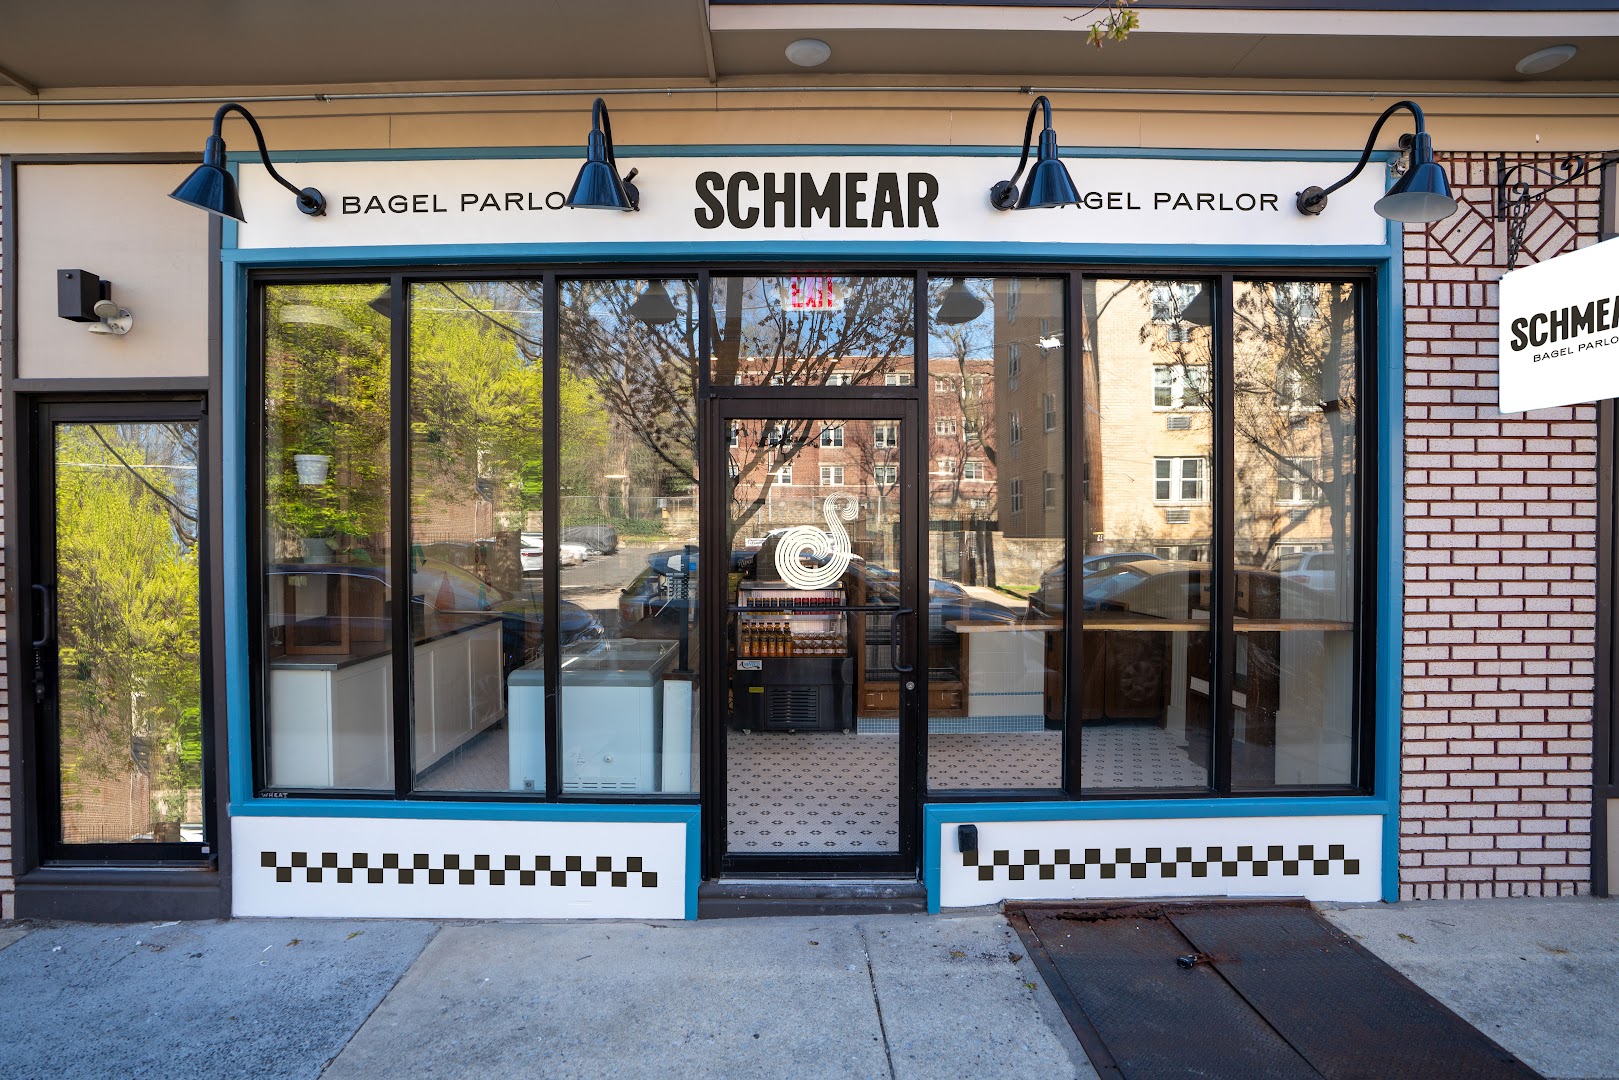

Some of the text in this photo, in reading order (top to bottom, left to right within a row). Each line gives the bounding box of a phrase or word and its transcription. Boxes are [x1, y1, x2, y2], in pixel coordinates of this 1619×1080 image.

[342, 191, 576, 215] BAGEL PARLO
[694, 171, 940, 229] SCHMEAR
[1049, 191, 1279, 211] GEL PARLOR
[1533, 346, 1574, 363] BAGEL
